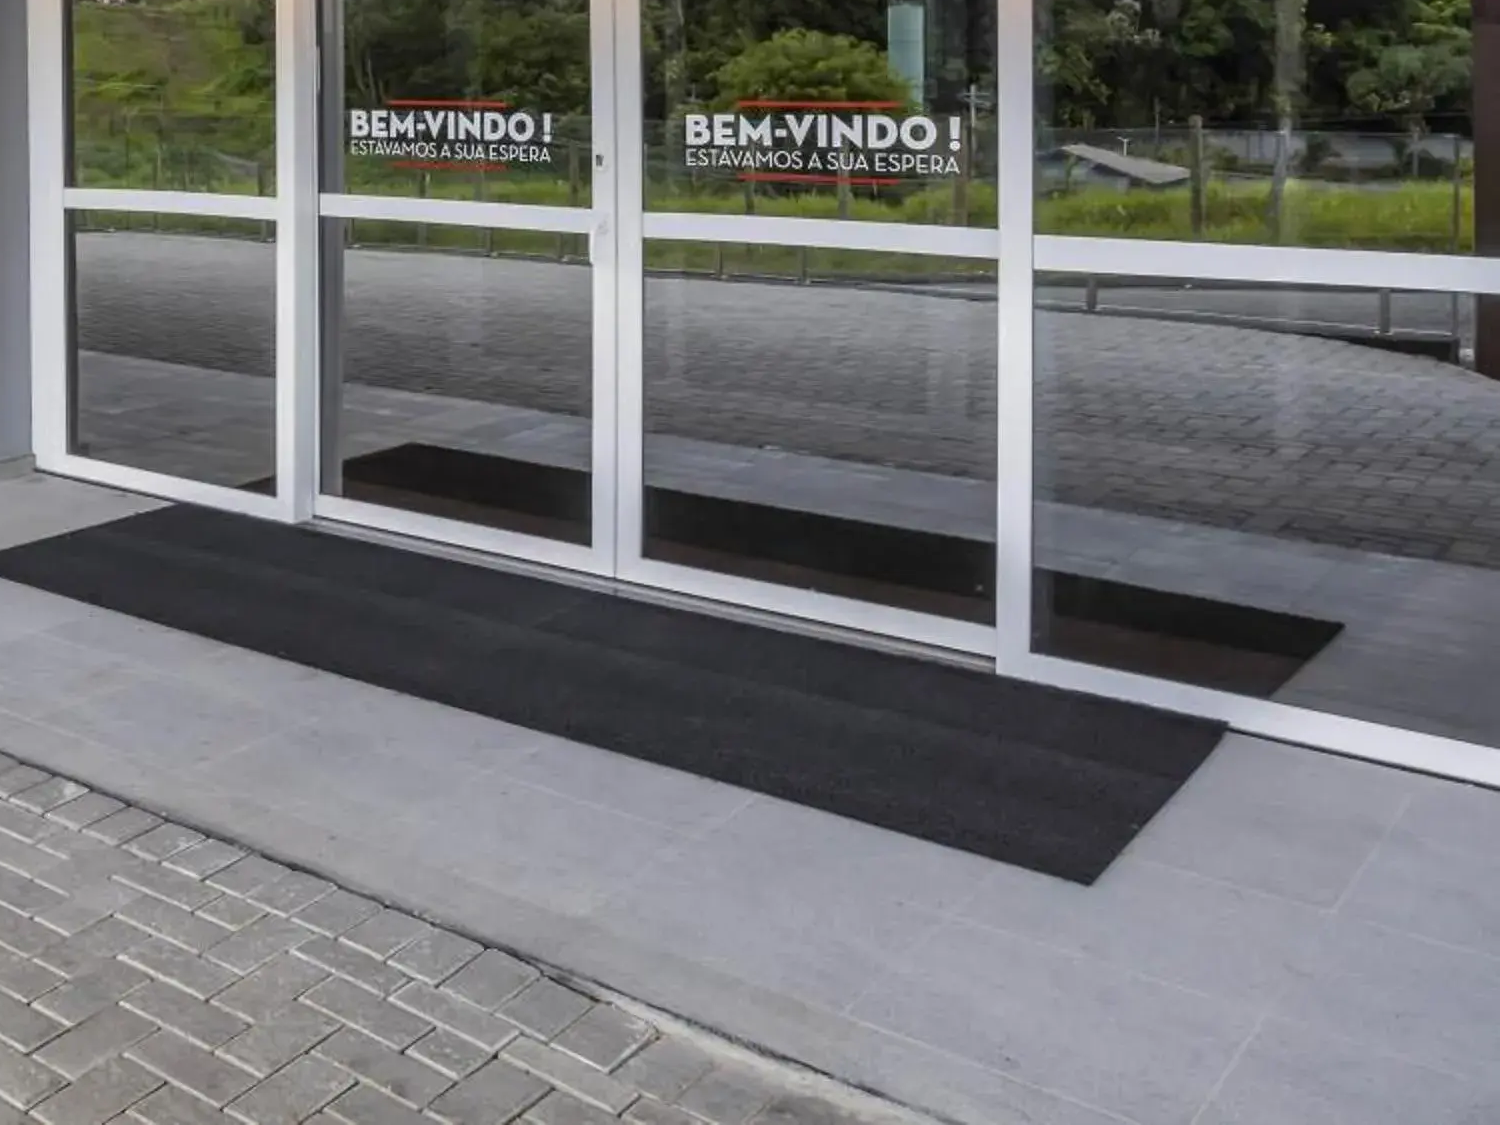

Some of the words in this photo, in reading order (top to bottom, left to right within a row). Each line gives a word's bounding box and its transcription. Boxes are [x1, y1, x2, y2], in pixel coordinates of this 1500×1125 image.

[351, 109, 535, 142] BEM-VINDO
[542, 112, 552, 143] !
[685, 114, 937, 150] BEM-VINDO
[949, 116, 961, 152] !
[441, 144, 450, 158] A
[455, 143, 484, 160] SUA
[489, 144, 551, 163] ESPERA
[807, 152, 822, 170] A
[826, 152, 869, 172] SUA
[875, 153, 960, 175] ESPERA
